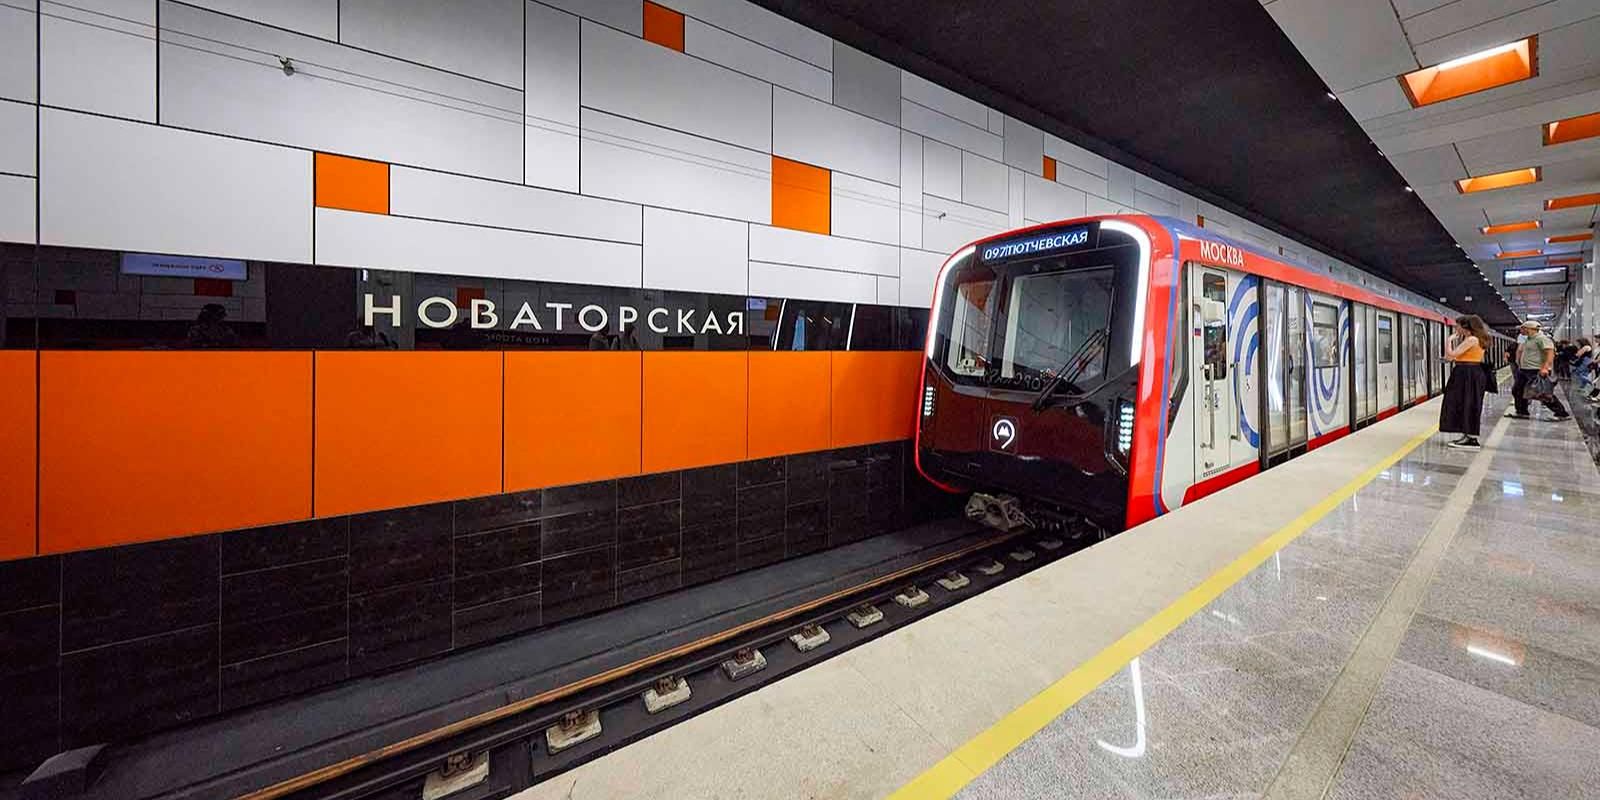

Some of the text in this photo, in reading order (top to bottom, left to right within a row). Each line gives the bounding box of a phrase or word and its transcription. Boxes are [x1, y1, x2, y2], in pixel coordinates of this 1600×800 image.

[1006, 231, 1088, 255] ТЮТЧЕВСКАЯ
[1200, 240, 1244, 267] МОСКВА
[364, 293, 744, 336] НОВАТОРСКАЯ
